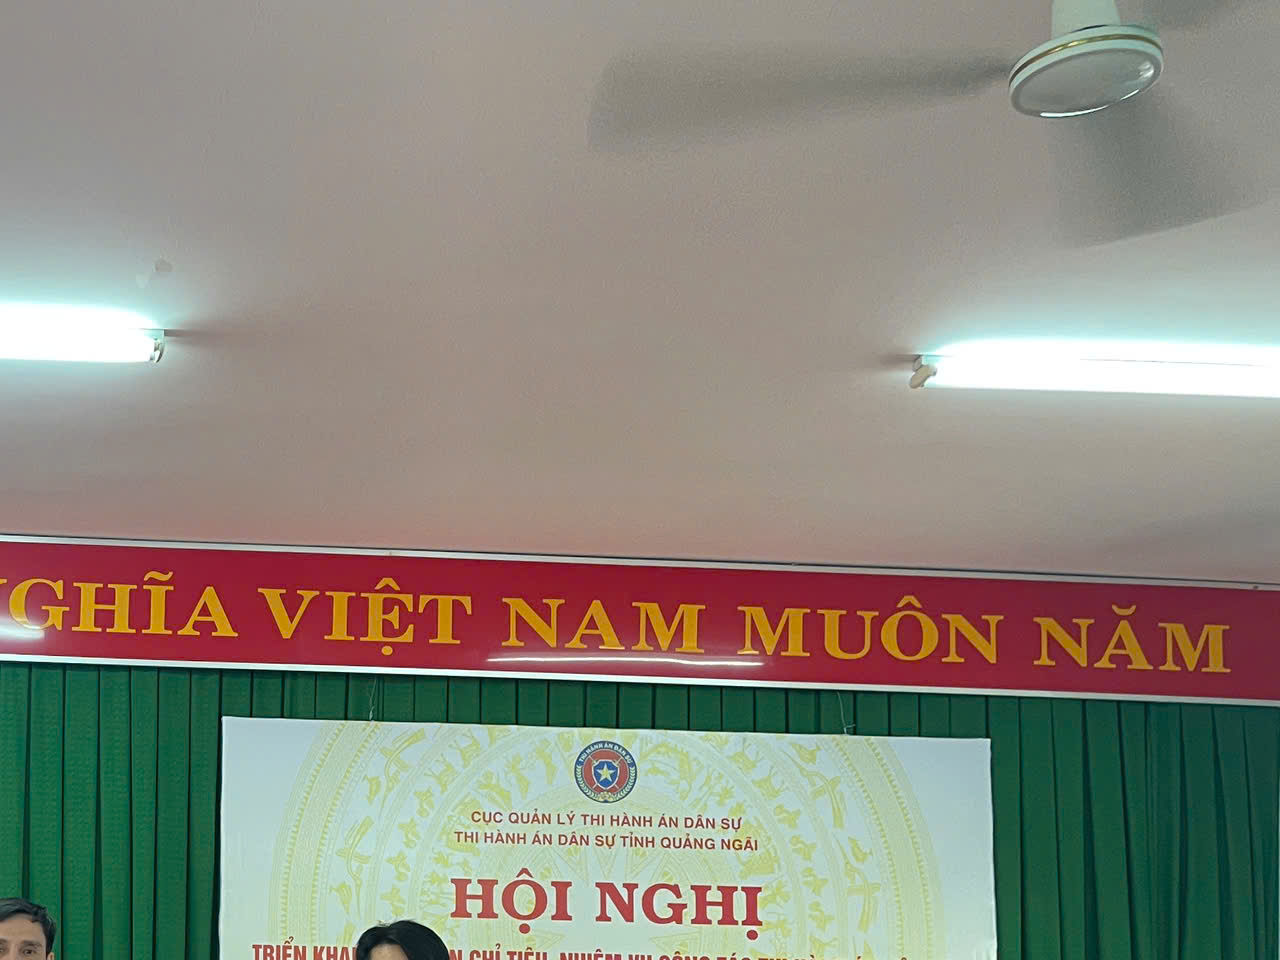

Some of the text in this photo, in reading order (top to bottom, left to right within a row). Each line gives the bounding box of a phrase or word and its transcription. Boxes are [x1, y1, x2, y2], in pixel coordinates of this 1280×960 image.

[257, 578, 472, 655] VIỆT
[502, 597, 706, 653] NAM
[738, 595, 1003, 664] MUÔN
[1033, 605, 1231, 673] NĂM
[454, 830, 758, 851] THI HÀNH ÁN DÂN SỰ TỈNH QUẢNG NGÃI
[471, 809, 742, 831] CỤC QUẢN LÝ THI HÀNH ÁN DÂN SỰ
[450, 868, 763, 940] HỘI NGHỊ
